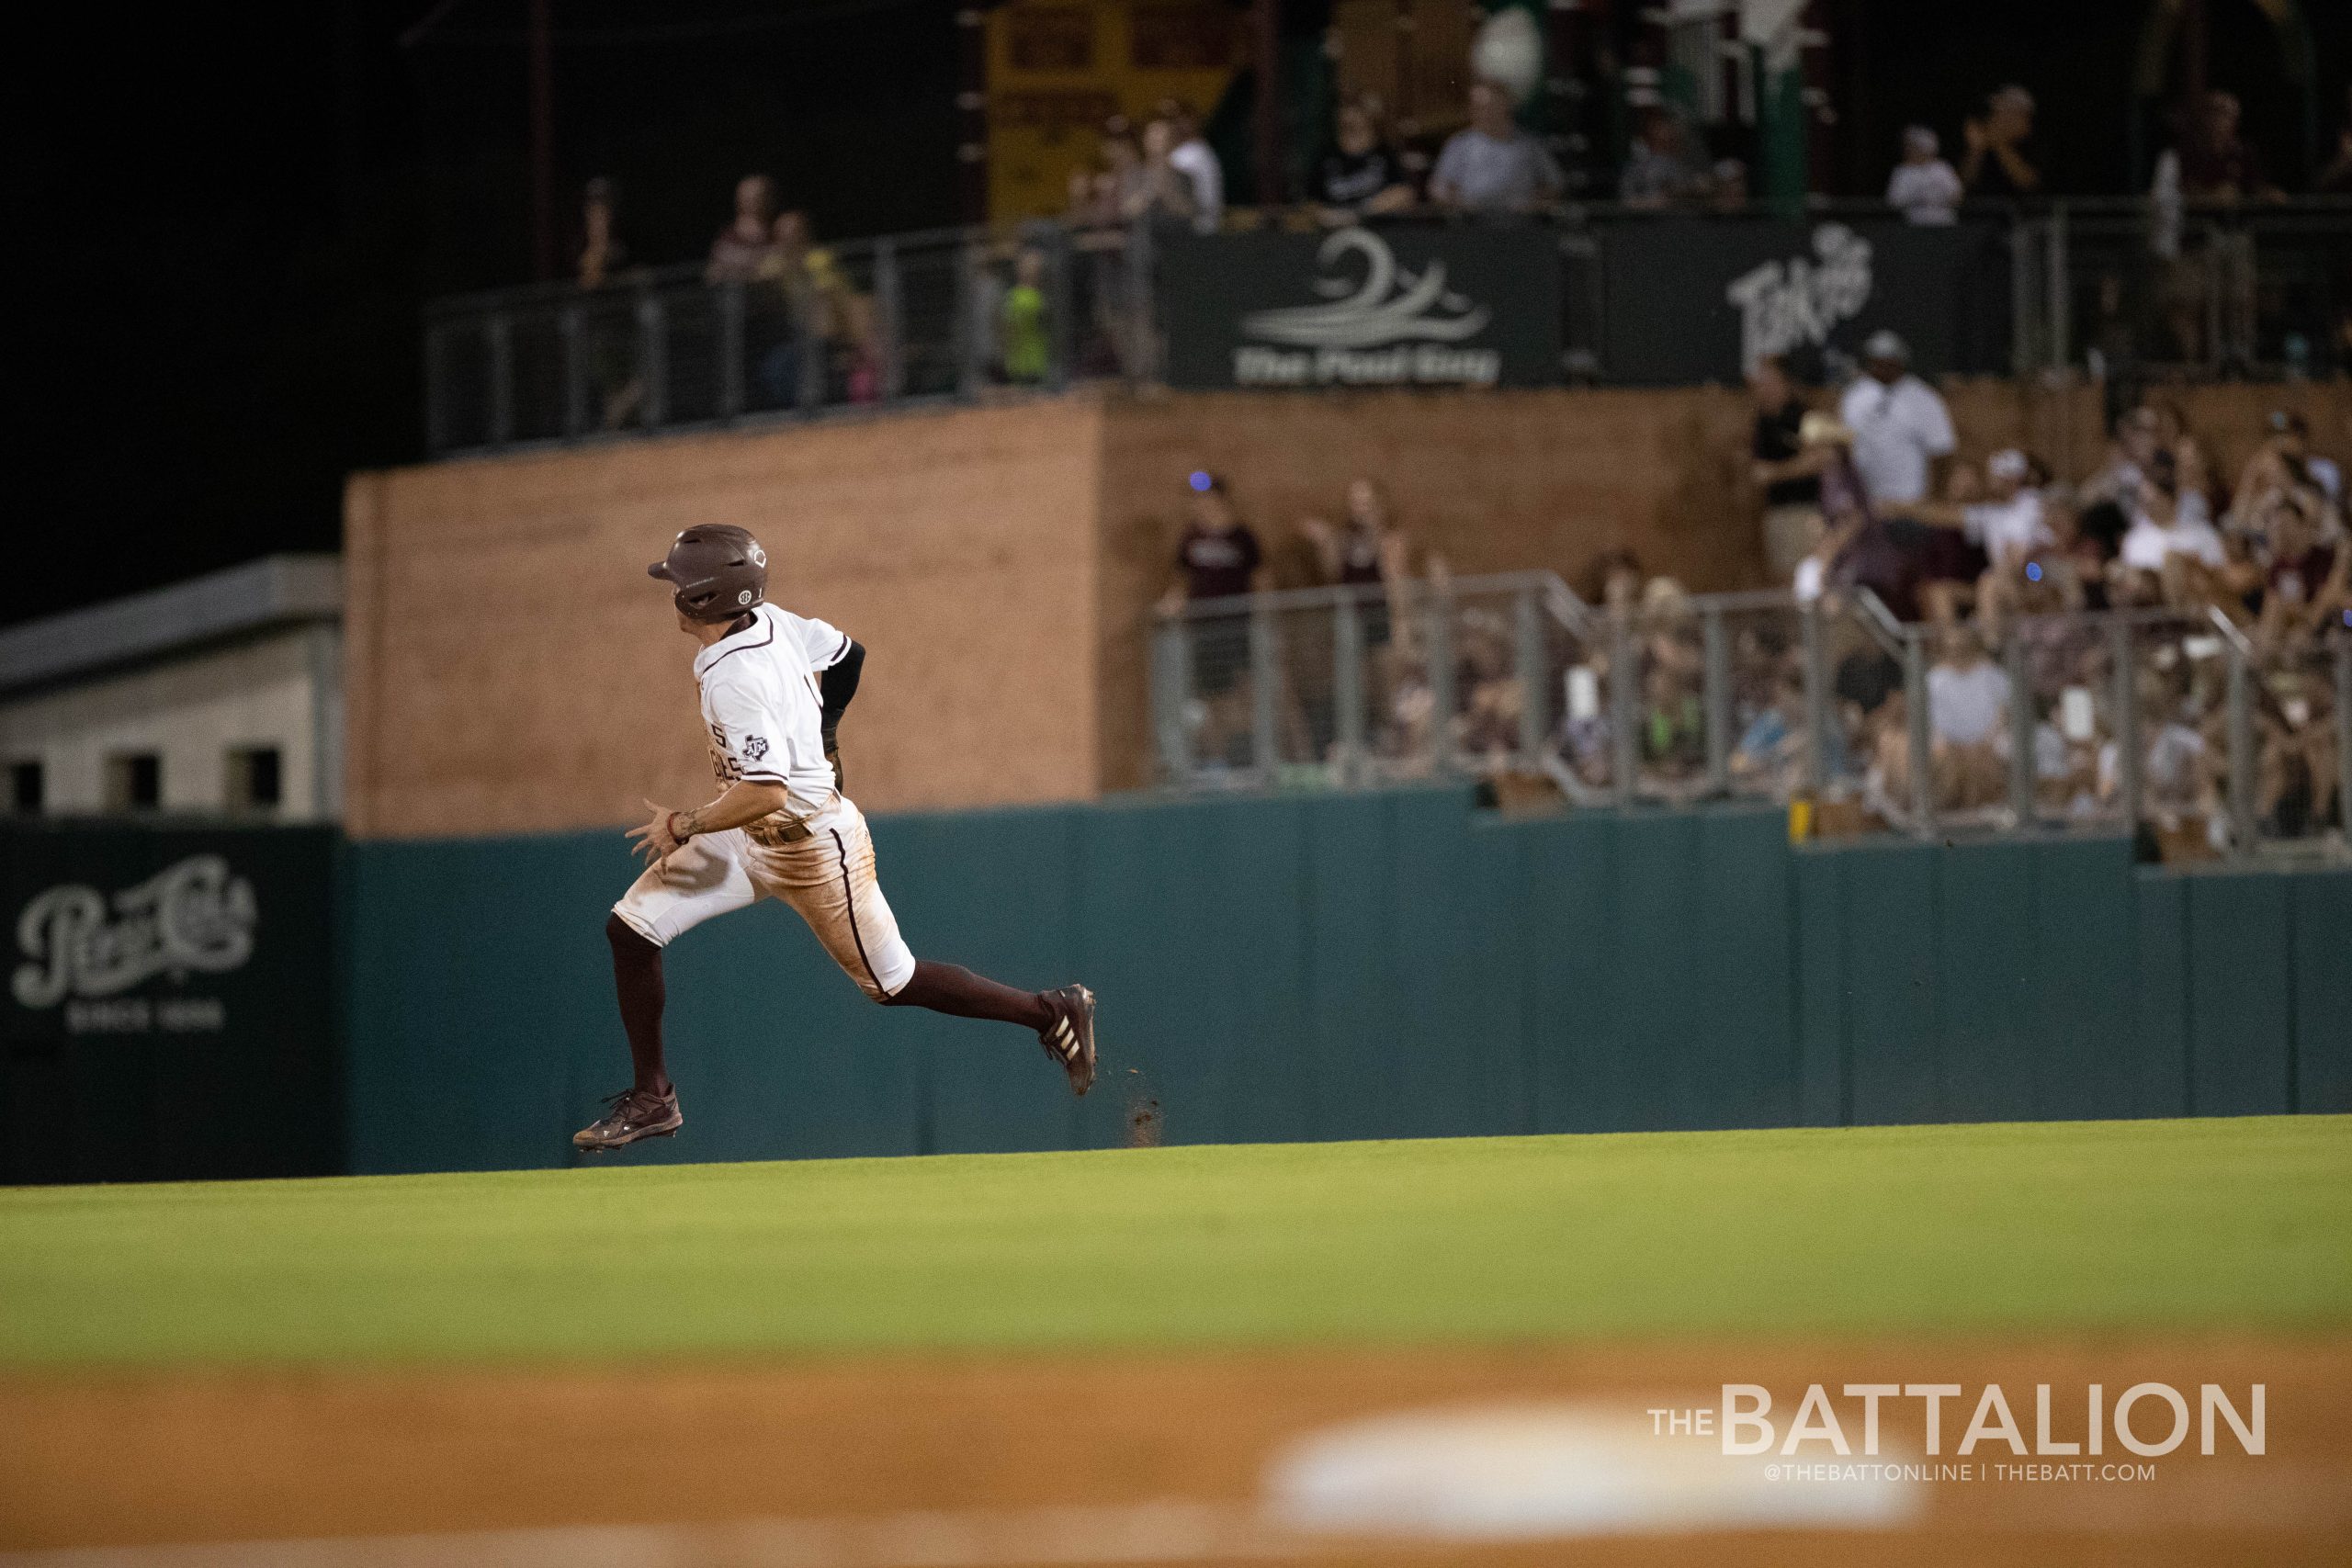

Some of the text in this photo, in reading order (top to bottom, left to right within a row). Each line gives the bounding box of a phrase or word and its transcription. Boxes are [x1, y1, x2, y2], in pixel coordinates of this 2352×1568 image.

[1233, 344, 1502, 385] The Pool Guy
[739, 591, 752, 604] SEC
